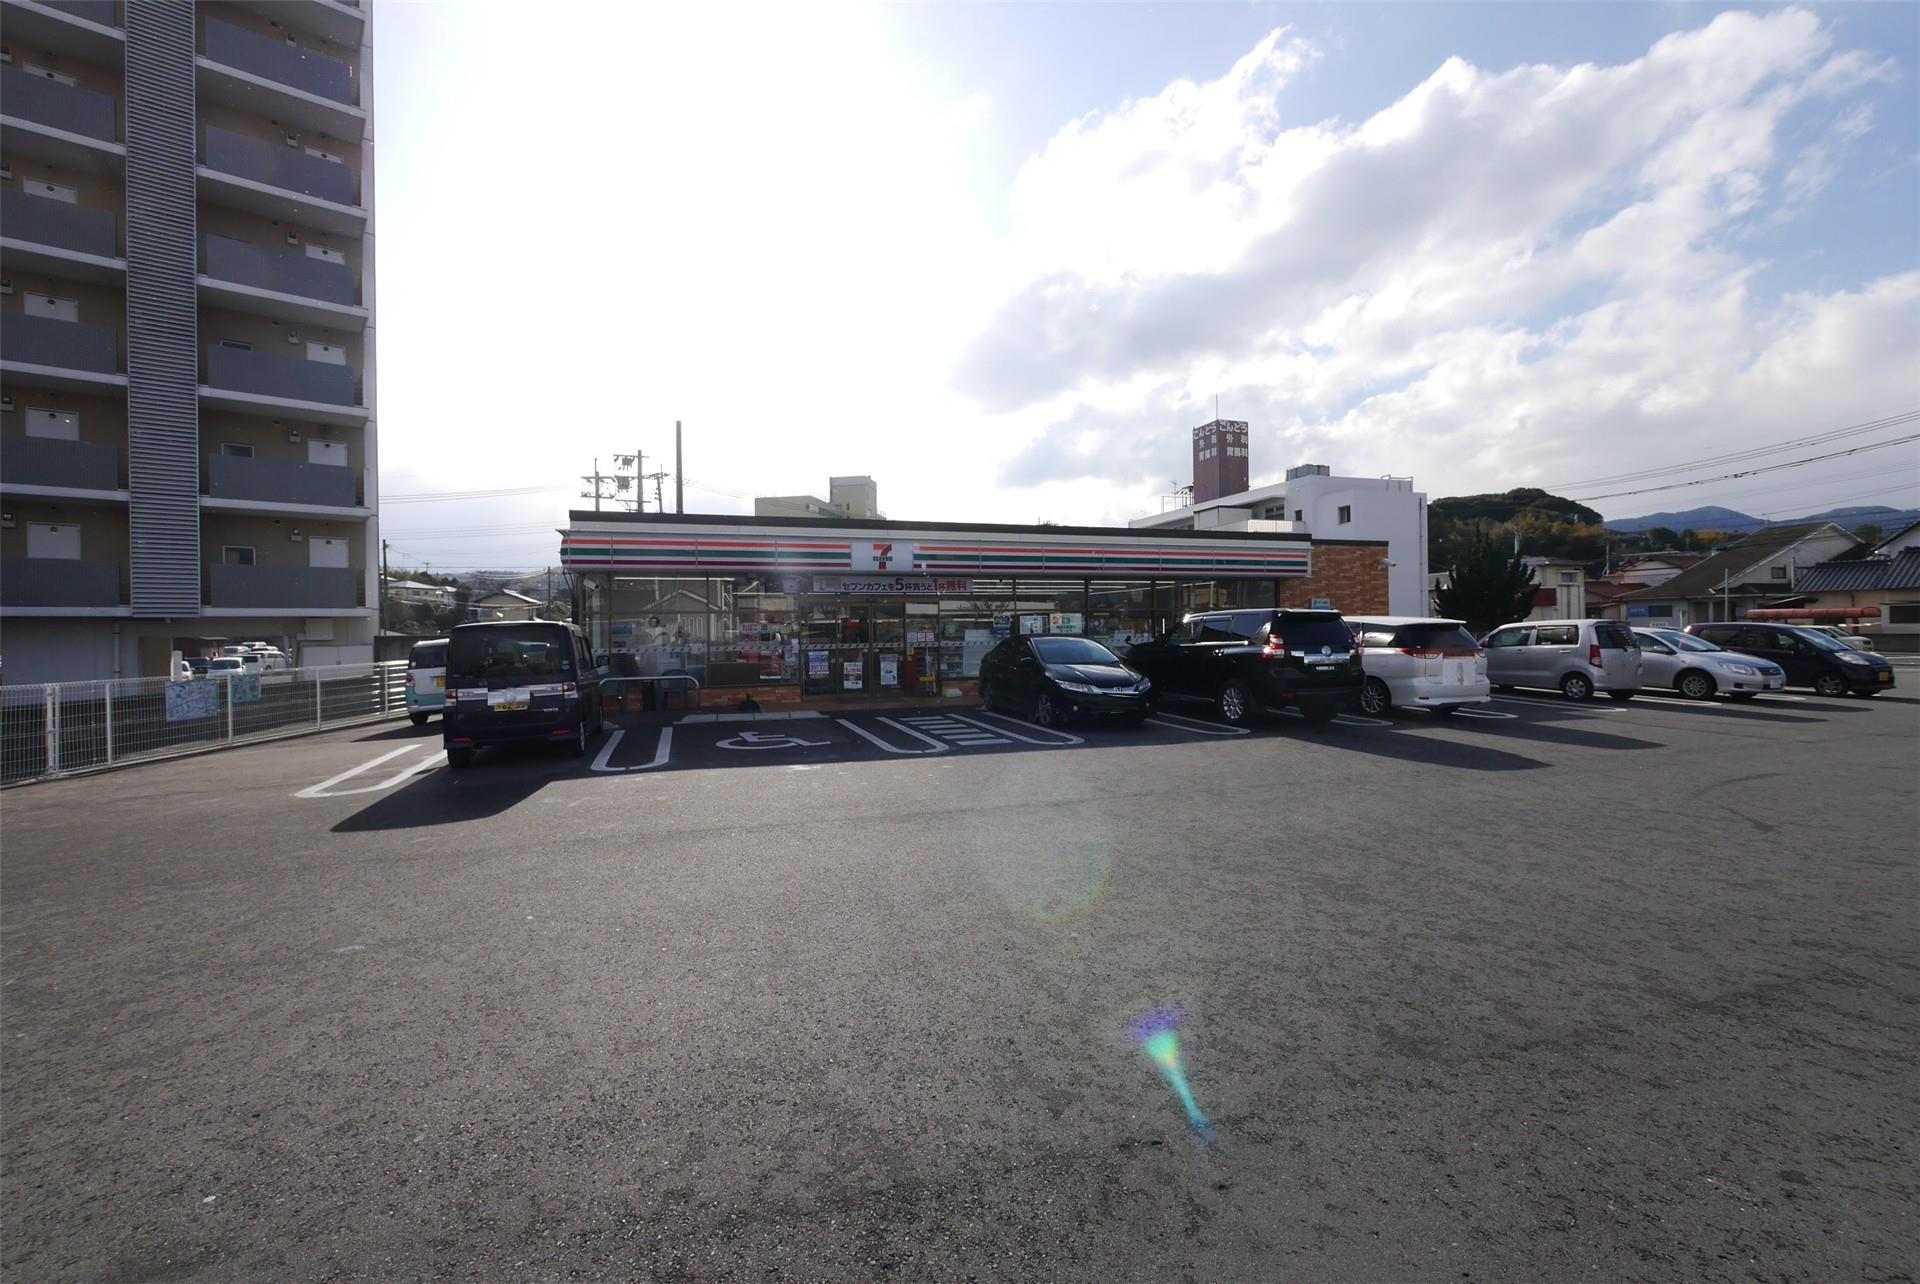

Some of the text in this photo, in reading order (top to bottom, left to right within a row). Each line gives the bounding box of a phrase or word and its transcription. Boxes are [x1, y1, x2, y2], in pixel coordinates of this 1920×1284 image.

[1219, 420, 1248, 433] こんどう
[873, 543, 892, 570] 7
